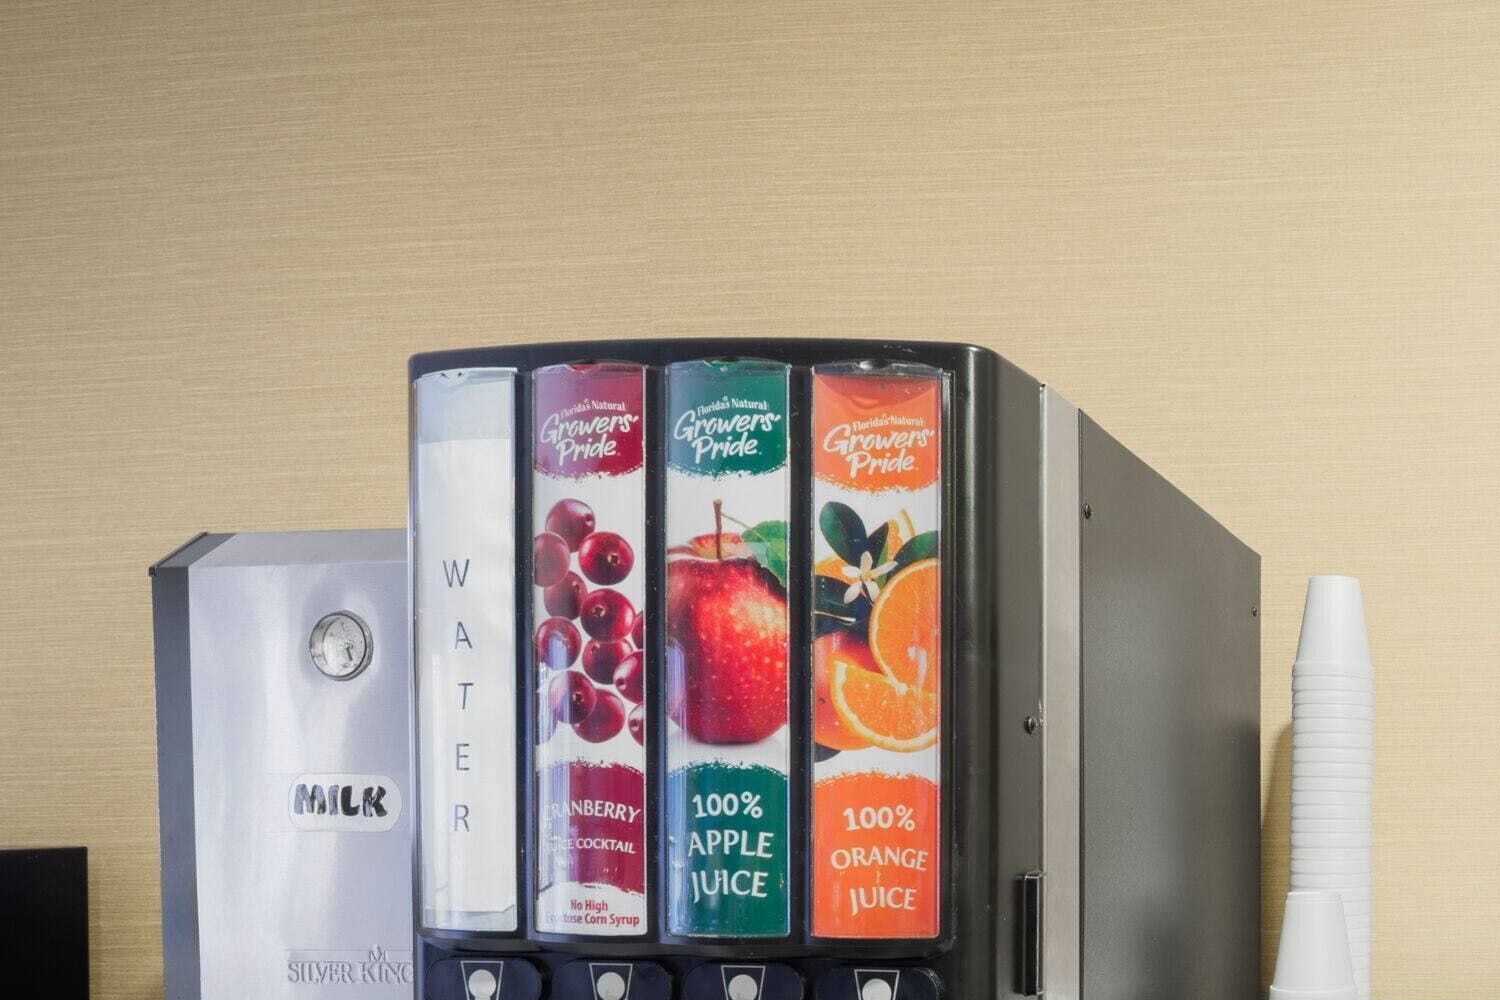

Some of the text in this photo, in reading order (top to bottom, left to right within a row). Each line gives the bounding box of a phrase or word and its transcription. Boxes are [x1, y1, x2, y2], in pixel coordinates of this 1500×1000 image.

[591, 400, 626, 411] Natural
[731, 398, 768, 411] Natural
[890, 415, 924, 427] Natural
[555, 433, 617, 467] Pride
[691, 432, 758, 465] Pride
[845, 448, 915, 479] Pride
[442, 558, 474, 832] WATER
[293, 783, 388, 818] MILK
[691, 791, 764, 819] 100%
[842, 804, 916, 832] 100%
[575, 838, 637, 855] COCKTAIL
[688, 829, 774, 859] APPLE
[830, 845, 929, 872] ORANGE
[691, 869, 769, 903] JUICE
[570, 899, 609, 914] No High
[849, 886, 917, 916] JUICE
[584, 912, 609, 925] Corn
[609, 913, 641, 928] Syrup
[287, 960, 353, 984] SILVER
